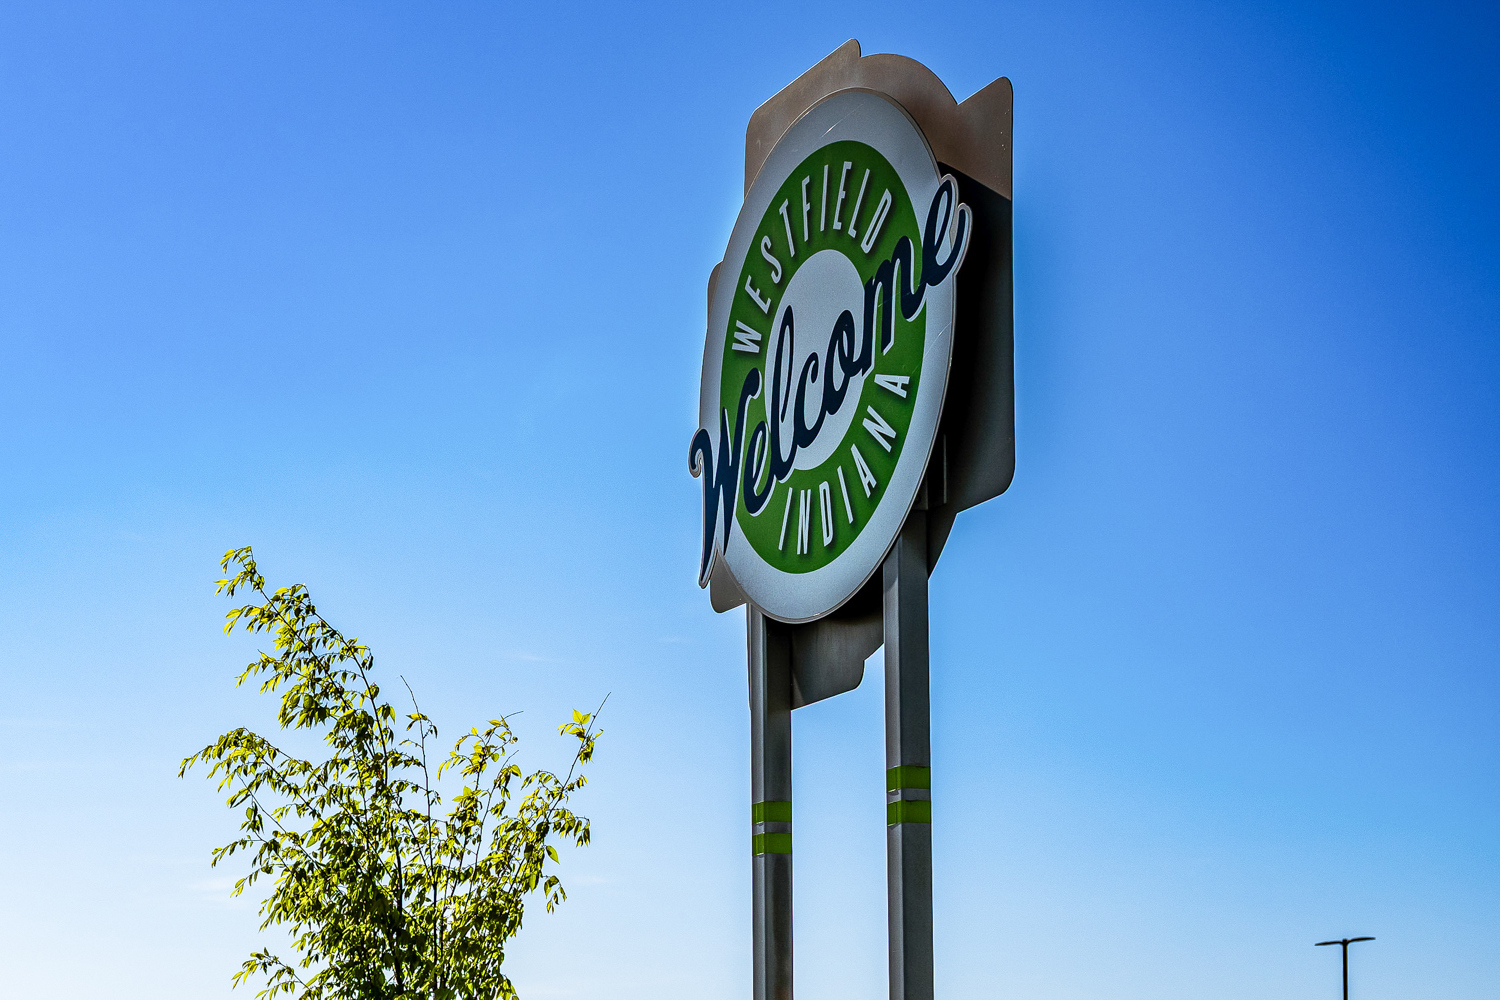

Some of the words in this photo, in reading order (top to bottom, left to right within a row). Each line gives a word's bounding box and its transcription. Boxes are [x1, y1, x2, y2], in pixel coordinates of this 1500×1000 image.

[732, 161, 892, 355] WESTFIELD
[691, 179, 967, 586] Welcome
[779, 373, 912, 555] INDIANA
